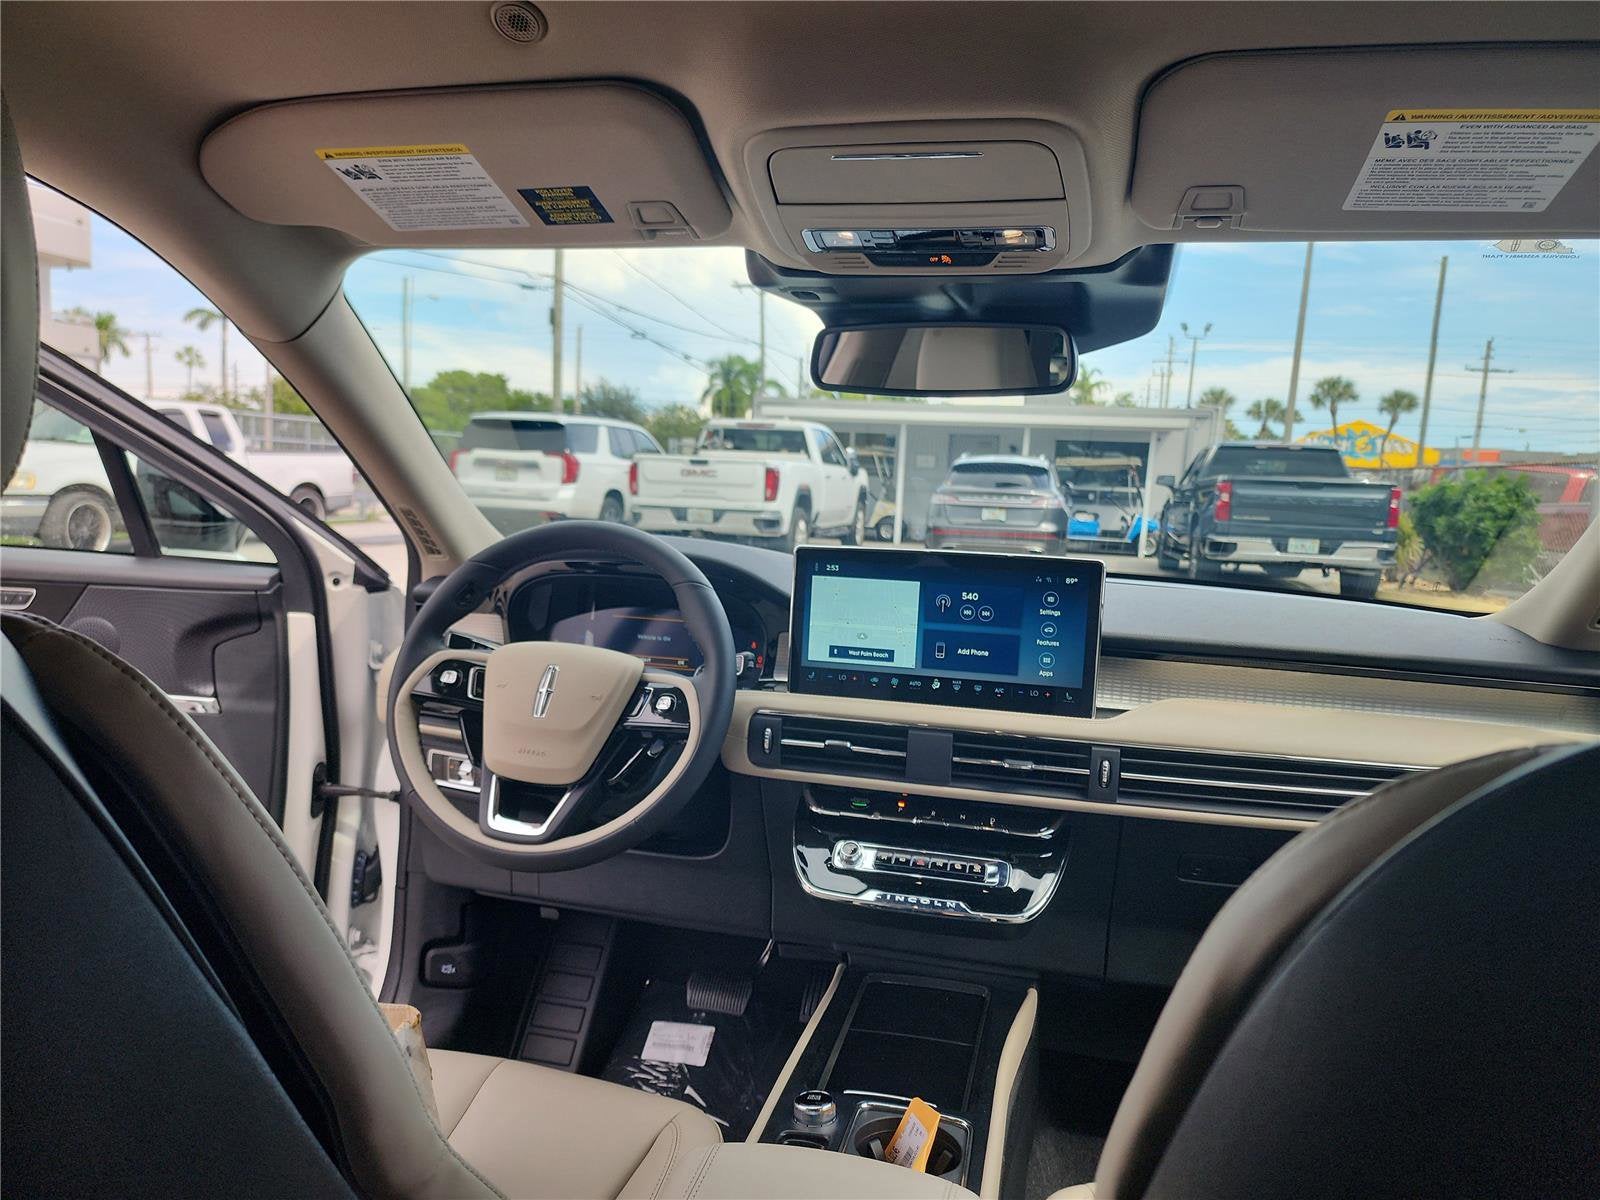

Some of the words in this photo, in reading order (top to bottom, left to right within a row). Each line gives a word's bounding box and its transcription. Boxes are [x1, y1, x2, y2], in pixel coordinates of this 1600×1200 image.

[681, 468, 718, 478] GMC
[962, 592, 978, 600] 540
[1040, 608, 1060, 616] Settings
[970, 648, 989, 656] Phone
